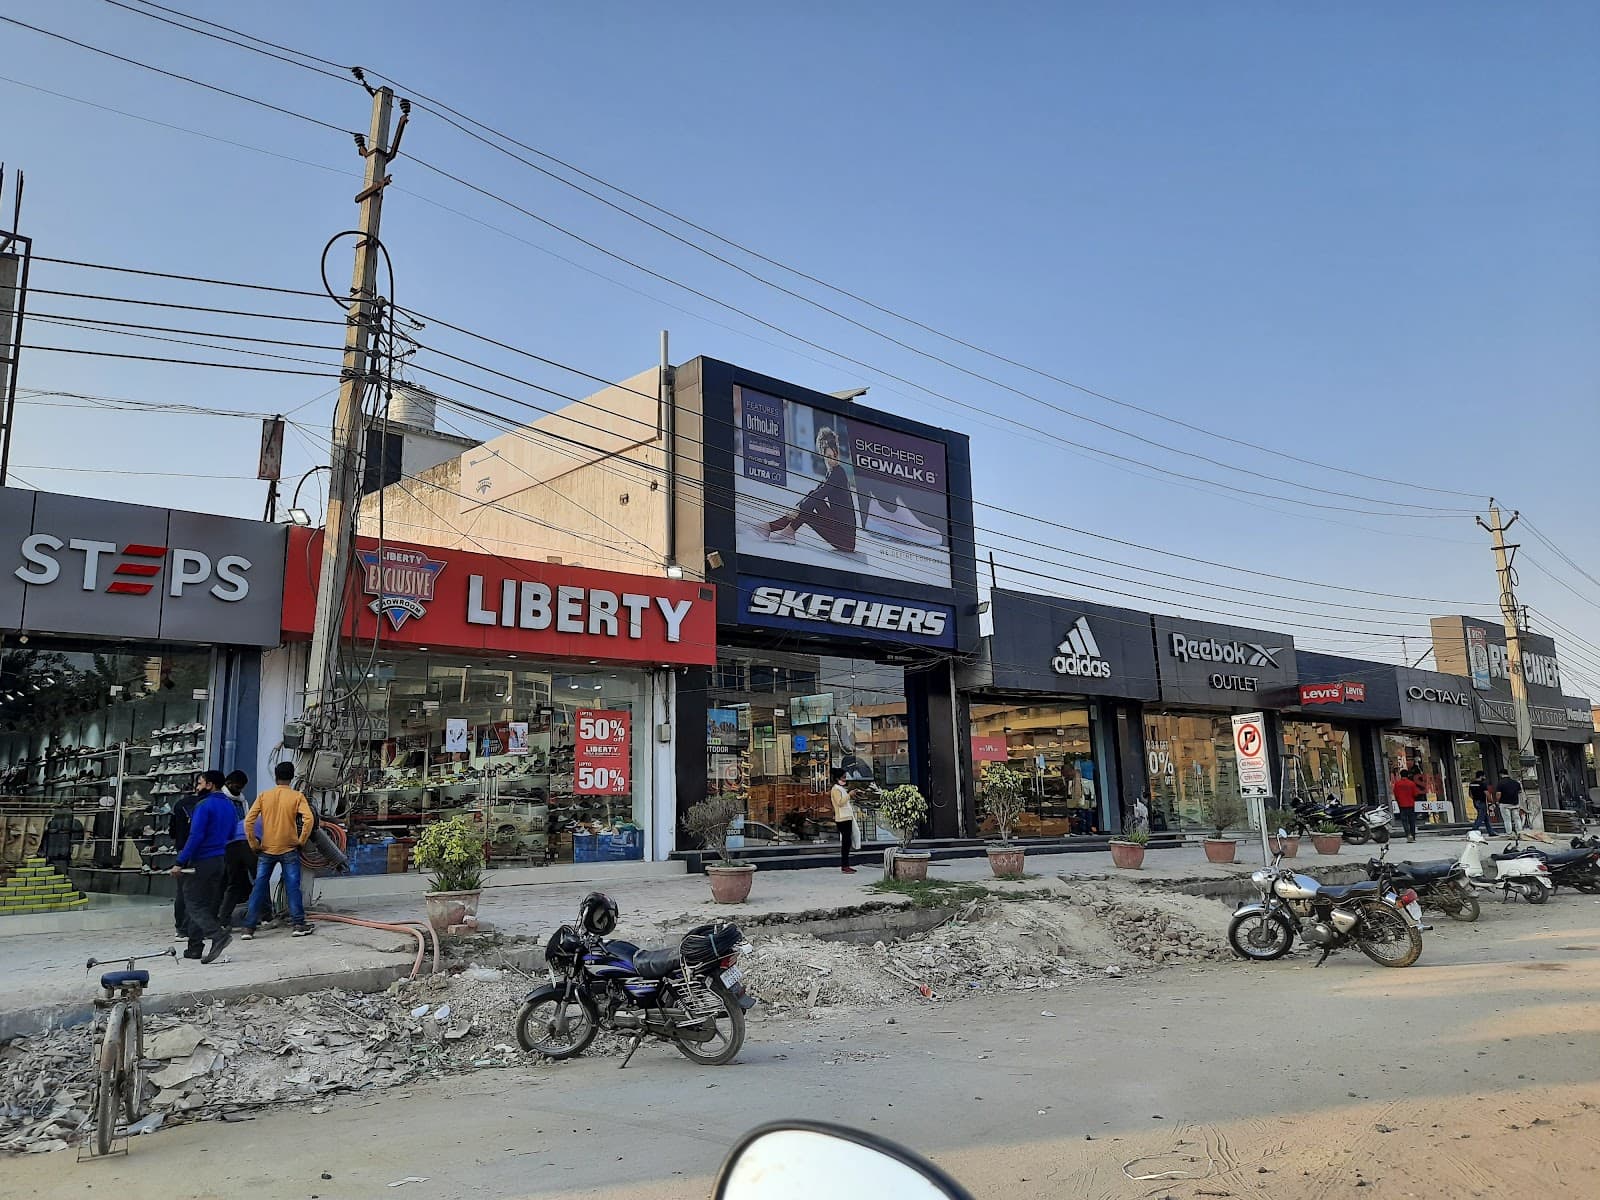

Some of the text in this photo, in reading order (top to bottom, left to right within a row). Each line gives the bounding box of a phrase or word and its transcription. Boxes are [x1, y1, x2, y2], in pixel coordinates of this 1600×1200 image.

[746, 400, 779, 415] FEATURES
[855, 439, 924, 466] SKECHERS
[748, 467, 770, 479] ULTRA
[856, 454, 936, 484] GOWALK 6
[14, 533, 253, 602] STEPS
[382, 551, 423, 565] LIBERTY
[368, 565, 431, 596] EXCLUSIVE
[467, 574, 693, 642] LIBERTY
[748, 586, 947, 636] SKECHERS
[1171, 632, 1246, 664] Reebok
[1053, 652, 1111, 678] adidas
[1487, 643, 1511, 681] RE
[1212, 673, 1259, 693] OUTLET
[1408, 685, 1468, 707] OCTAVE
[579, 718, 625, 739] 50%
[578, 767, 625, 789] 50%
